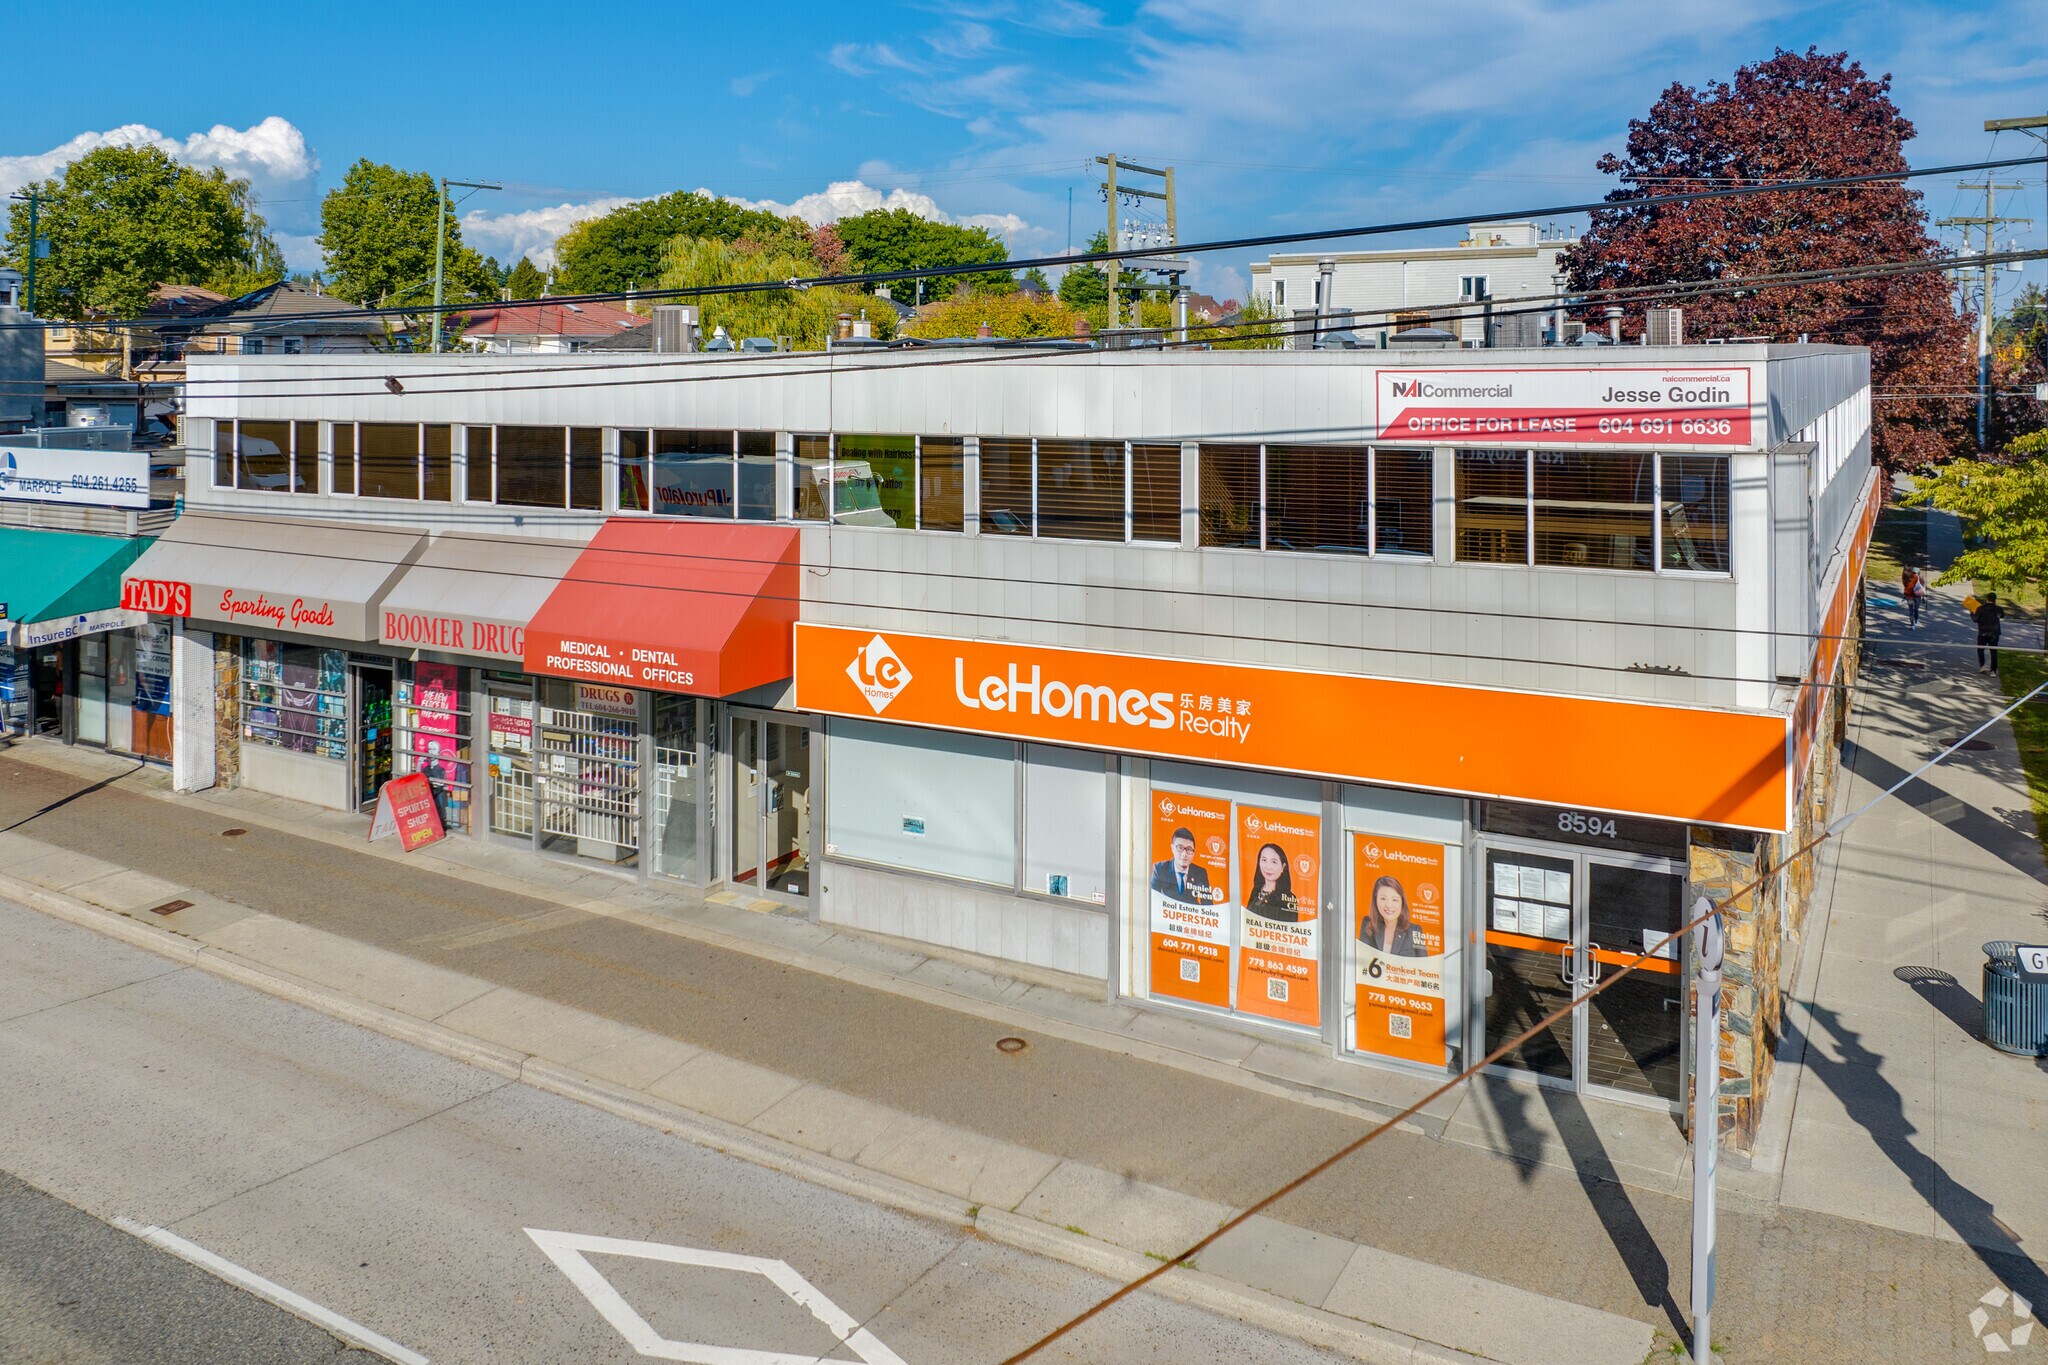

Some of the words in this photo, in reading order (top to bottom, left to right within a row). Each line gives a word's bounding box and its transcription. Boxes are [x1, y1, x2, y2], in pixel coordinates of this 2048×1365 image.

[1662, 375, 1731, 383] naicommercial.ca
[1602, 387, 1661, 402] Jesse
[1668, 387, 1730, 402] Godin
[1408, 417, 1470, 431] OFFICE
[1475, 417, 1513, 432] FOR
[1518, 417, 1577, 433] LEASE
[1599, 418, 1634, 434] 604
[1640, 418, 1672, 434] 691
[1681, 418, 1731, 435] 6636
[19, 479, 62, 495] MARPOLE
[72, 474, 137, 493] 604.261.4255
[128, 580, 188, 616] TAD'S
[220, 589, 286, 628] Sporting
[290, 598, 334, 628] Goods
[29, 626, 79, 645] InsureBC
[90, 620, 126, 631] MARPOLE
[385, 612, 464, 648] BOOMER
[561, 640, 611, 658] MEDICAL
[632, 649, 678, 666] DENTAL
[547, 655, 634, 678] PROFESSIONAL
[643, 667, 694, 685] OFFICES
[580, 686, 620, 703] DRUGS
[865, 686, 894, 699] Homes
[955, 657, 1175, 729] LeHomes
[1179, 693, 1251, 717] 乐房美家
[1179, 710, 1251, 744] Realty
[397, 799, 431, 817] SPORTS
[1177, 804, 1216, 819] LeHomes
[407, 813, 429, 828] SHOP
[1264, 820, 1305, 836] LeHomes
[1558, 812, 1617, 838] 8594
[411, 827, 433, 843] OPEN
[1383, 849, 1428, 865] LeHomes
[1187, 882, 1212, 893] Daniel
[1192, 890, 1213, 900] Chen
[1281, 893, 1300, 904] Ruby
[1162, 900, 1177, 910] Real
[1180, 904, 1199, 914] Estate
[1201, 908, 1219, 918] Sales
[1162, 909, 1219, 928] SUPERSTAR
[1245, 917, 1263, 928] REAL
[1265, 921, 1288, 932] ESTATE
[1290, 926, 1312, 936] SALES
[1249, 927, 1309, 947] SUPERSTAR
[1413, 930, 1440, 941] Elaine
[1162, 938, 1178, 949] 604
[1181, 941, 1195, 952] 771
[1198, 945, 1218, 956] 9218
[1248, 956, 1265, 967] 778
[1267, 960, 1284, 971] 863
[1286, 964, 1308, 975] 4589
[1386, 963, 1416, 976] Ranked
[1418, 969, 1440, 980] Team
[1369, 991, 1386, 1003] 778
[1388, 995, 1406, 1007] 990
[1409, 999, 1433, 1011] 9653
